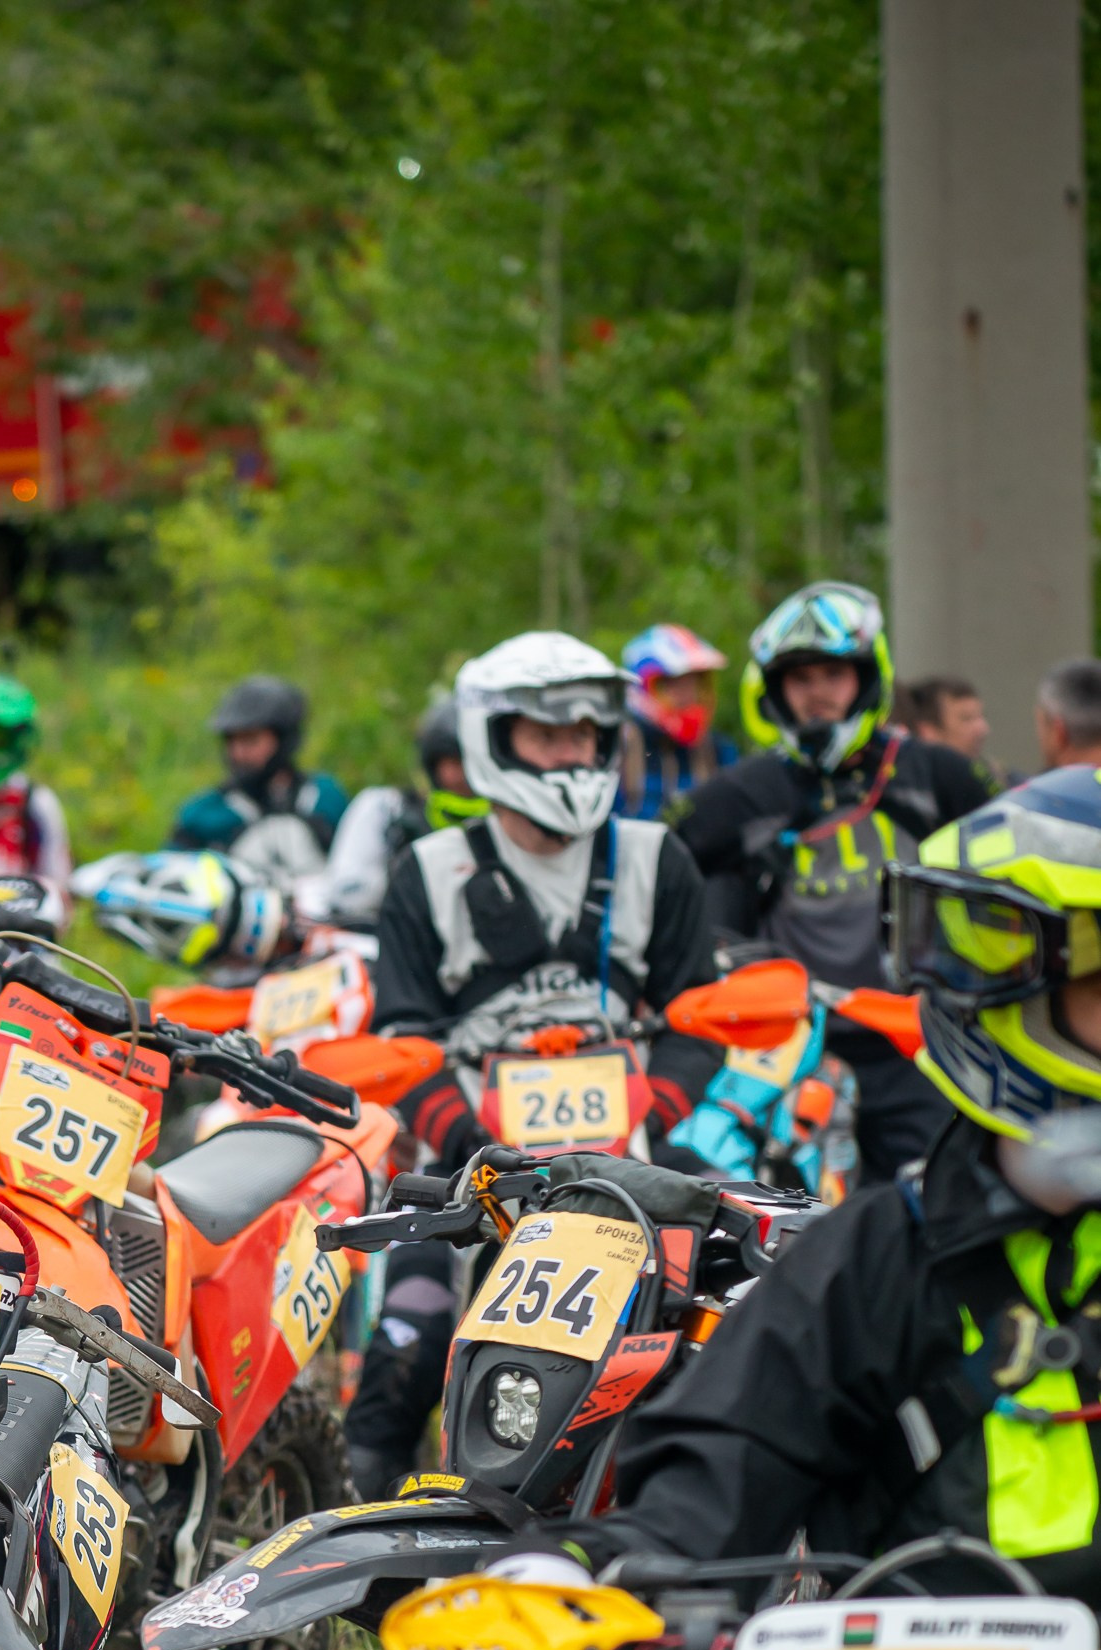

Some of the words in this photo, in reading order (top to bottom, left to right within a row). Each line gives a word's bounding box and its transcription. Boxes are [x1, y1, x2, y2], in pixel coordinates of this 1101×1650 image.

[110, 1049, 157, 1077] MTUL
[524, 1088, 608, 1129] 268
[16, 1096, 119, 1178] 257
[595, 1223, 645, 1246] БРОНЗА
[292, 1250, 342, 1344] 257
[479, 1258, 601, 1336] 254
[621, 1338, 668, 1354] KTM
[419, 1473, 467, 1488] ENDURO
[73, 1478, 117, 1594] 253
